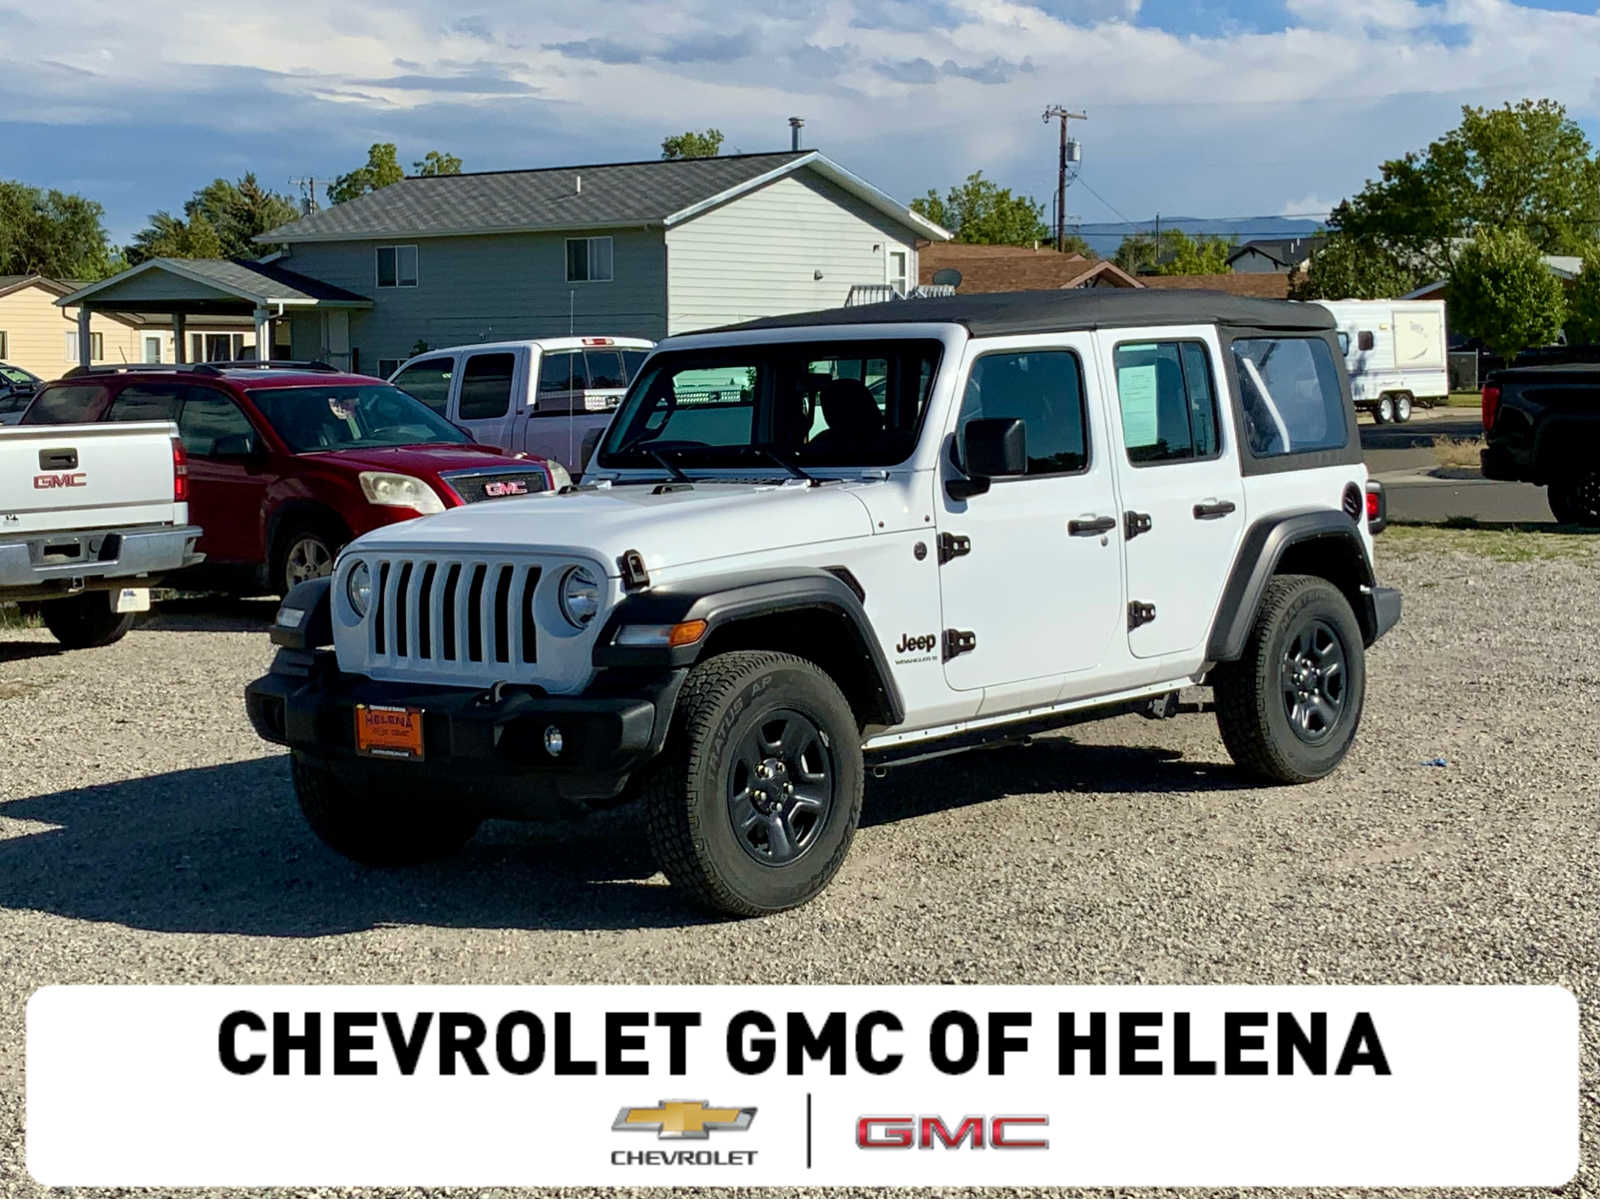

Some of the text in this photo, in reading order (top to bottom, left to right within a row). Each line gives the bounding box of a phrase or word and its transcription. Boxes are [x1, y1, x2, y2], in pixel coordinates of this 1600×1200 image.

[33, 472, 87, 489] GMC
[485, 481, 528, 496] GMC
[896, 633, 936, 653] Jeep
